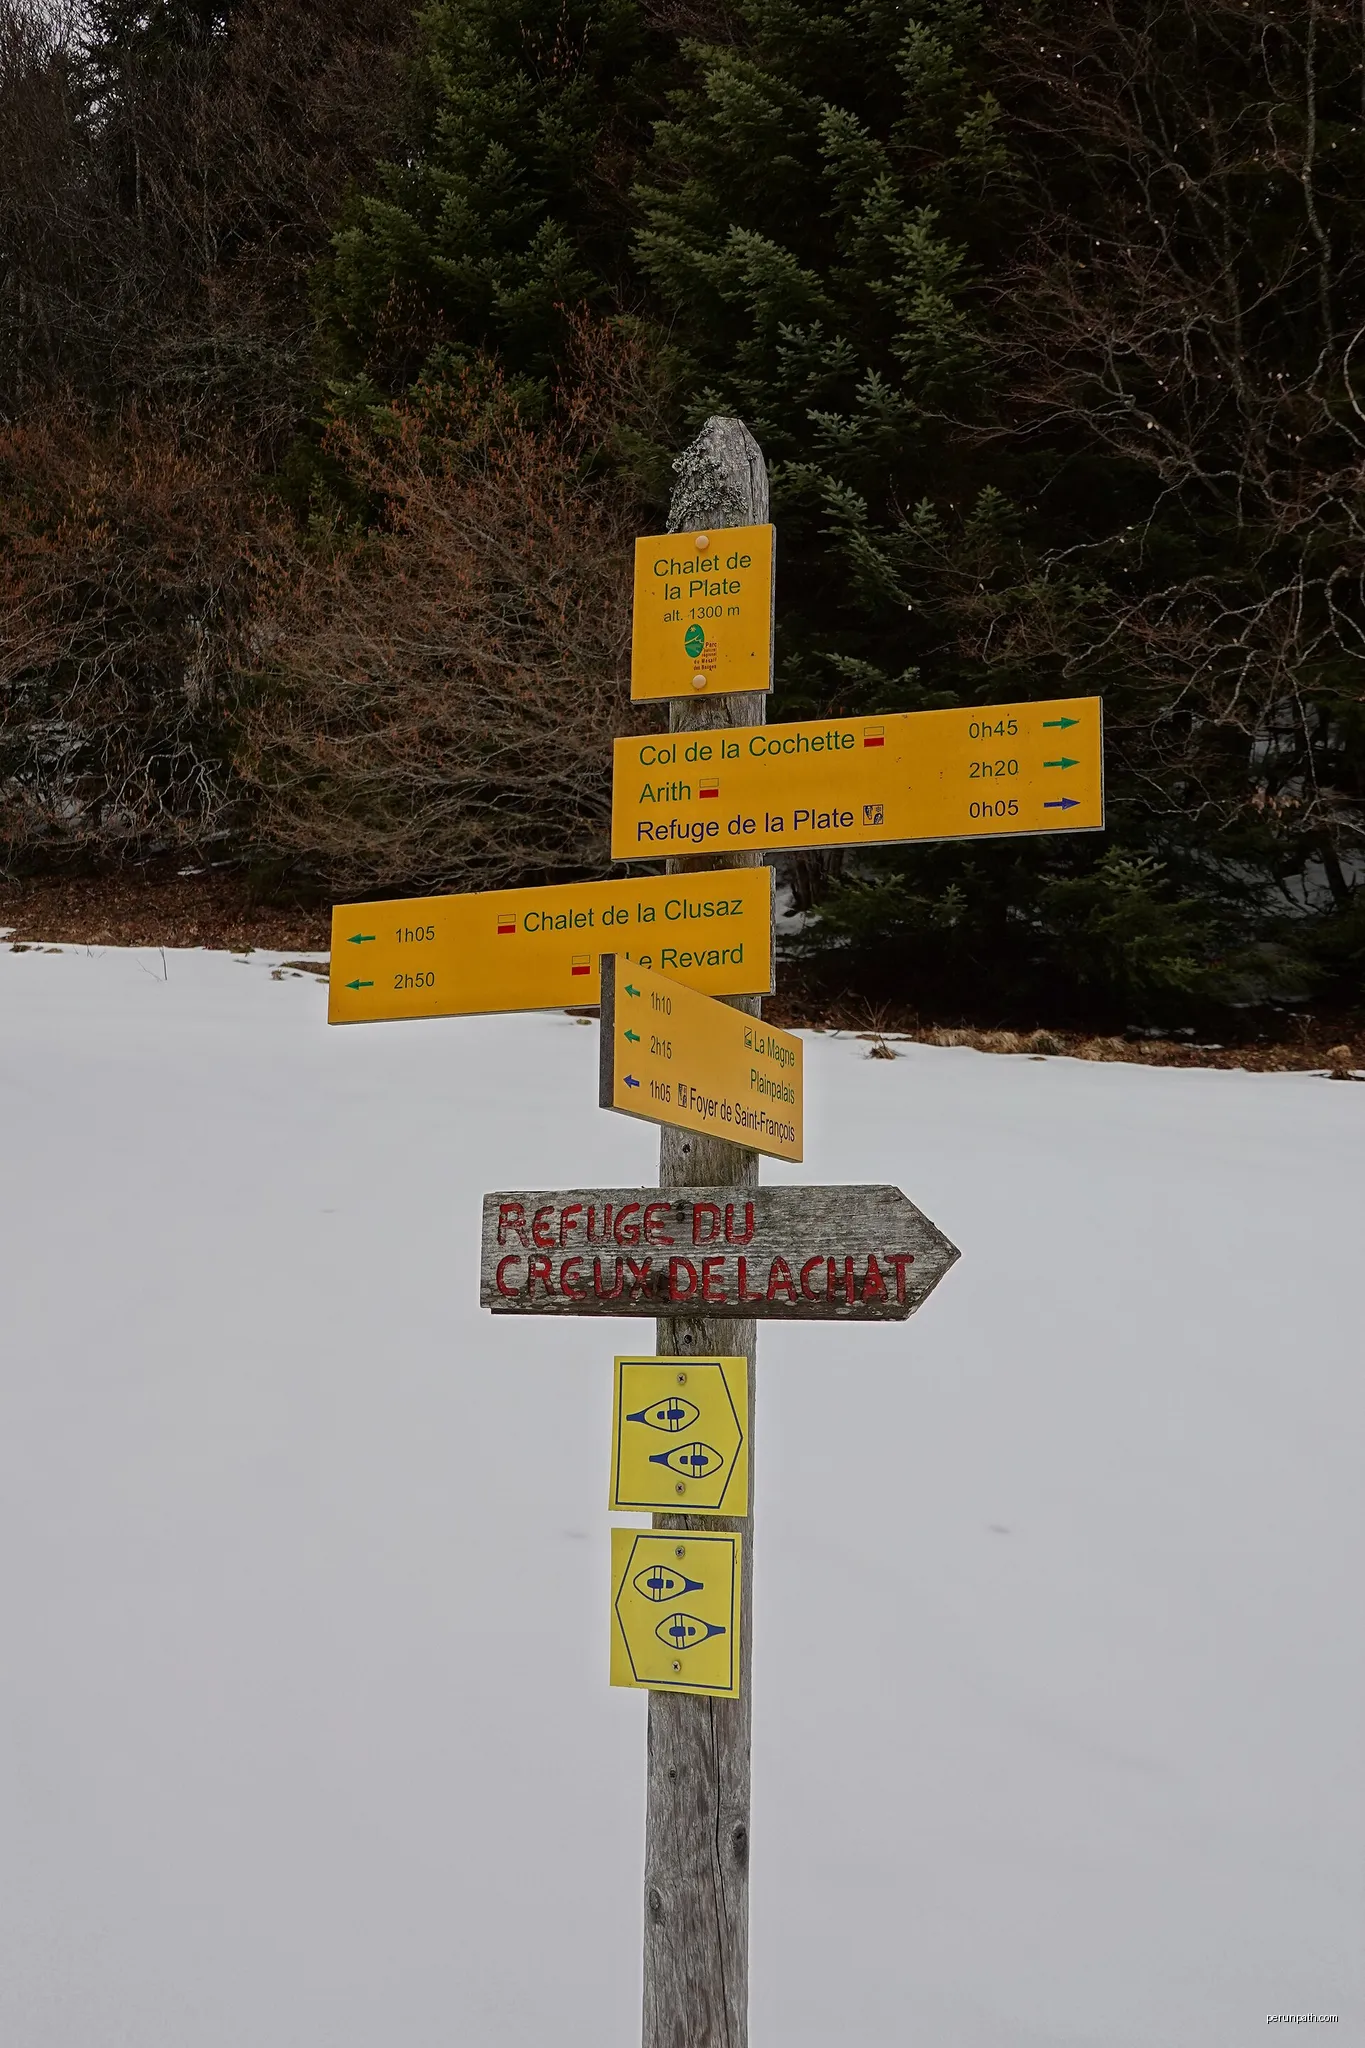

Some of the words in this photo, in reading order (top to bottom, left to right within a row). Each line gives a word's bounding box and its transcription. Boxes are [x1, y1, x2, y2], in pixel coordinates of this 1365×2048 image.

[653, 554, 720, 577] Chalet
[726, 552, 752, 570] de
[664, 583, 681, 600] la
[689, 578, 741, 598] Plate
[663, 609, 683, 623] alt.
[689, 605, 723, 620] 1300
[727, 606, 740, 616] m
[969, 719, 1018, 739] 0h45
[639, 743, 676, 766] Col
[684, 741, 712, 762] de
[721, 739, 740, 760] la
[749, 731, 855, 757] Cochette
[969, 759, 1018, 779] 2h20
[639, 780, 691, 803] Arith
[969, 800, 1019, 819] 0h05
[637, 818, 719, 843] Refuge
[727, 814, 756, 835] de
[765, 812, 784, 833] la
[793, 809, 854, 831] Plate
[523, 908, 594, 933] Chalet
[602, 905, 629, 926] de
[637, 903, 656, 923] la
[664, 898, 743, 921] Clusaz
[395, 925, 435, 943] 1h05
[661, 943, 743, 969] Revard
[393, 972, 435, 989] 2h50
[650, 991, 672, 1016] 1h10
[650, 1035, 672, 1059] 2h15
[754, 1030, 765, 1054] La
[767, 1036, 795, 1068] Magne
[649, 1079, 671, 1103] 1h05
[750, 1068, 795, 1105] Plainpalais
[689, 1087, 718, 1120] Foyer
[720, 1098, 732, 1122] de
[734, 1102, 795, 1143] Saint-François
[497, 1202, 675, 1249] REFUGE
[692, 1201, 754, 1247] DU
[496, 1253, 655, 1300] CREUX
